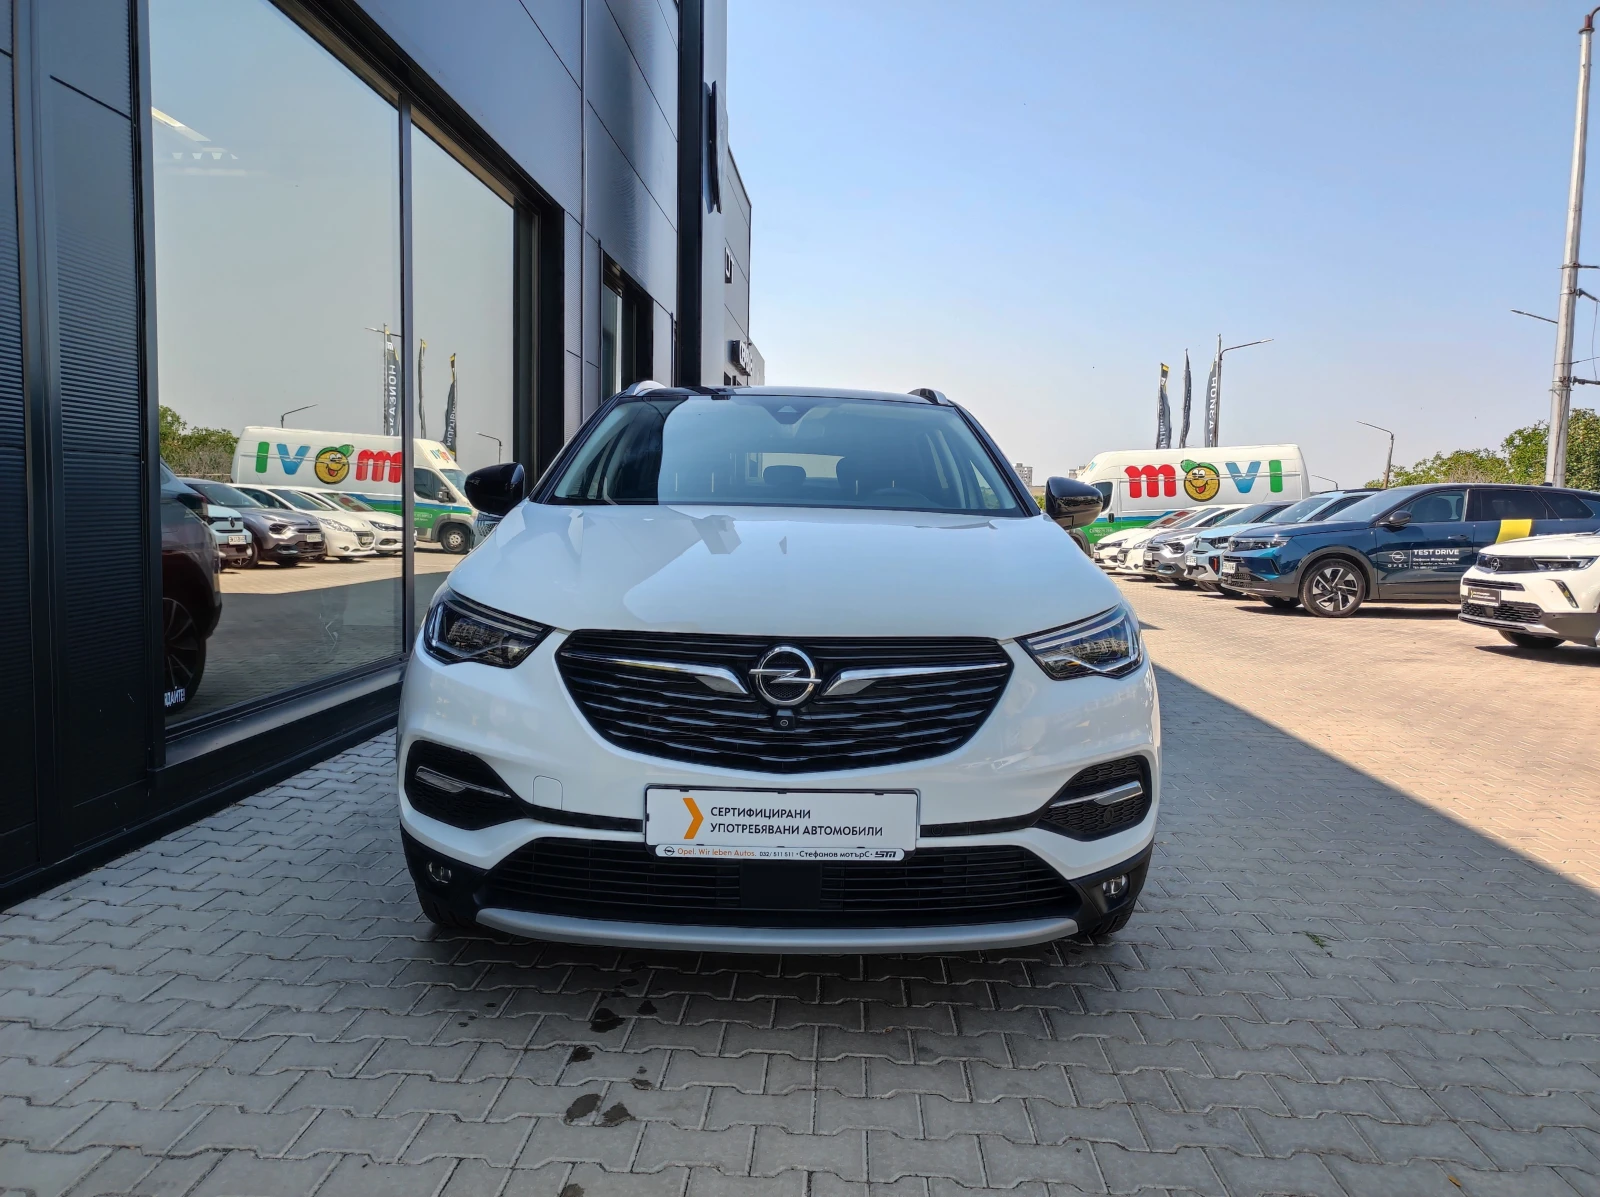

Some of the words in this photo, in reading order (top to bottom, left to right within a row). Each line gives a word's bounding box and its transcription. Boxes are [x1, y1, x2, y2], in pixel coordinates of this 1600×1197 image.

[710, 807, 811, 819] СЕРТИФИЦИРАНИ
[710, 823, 800, 835] УПОТРЕБЯВАНИ
[802, 826, 883, 836] АВТОМОБИЛИ
[677, 848, 697, 856] Opel.
